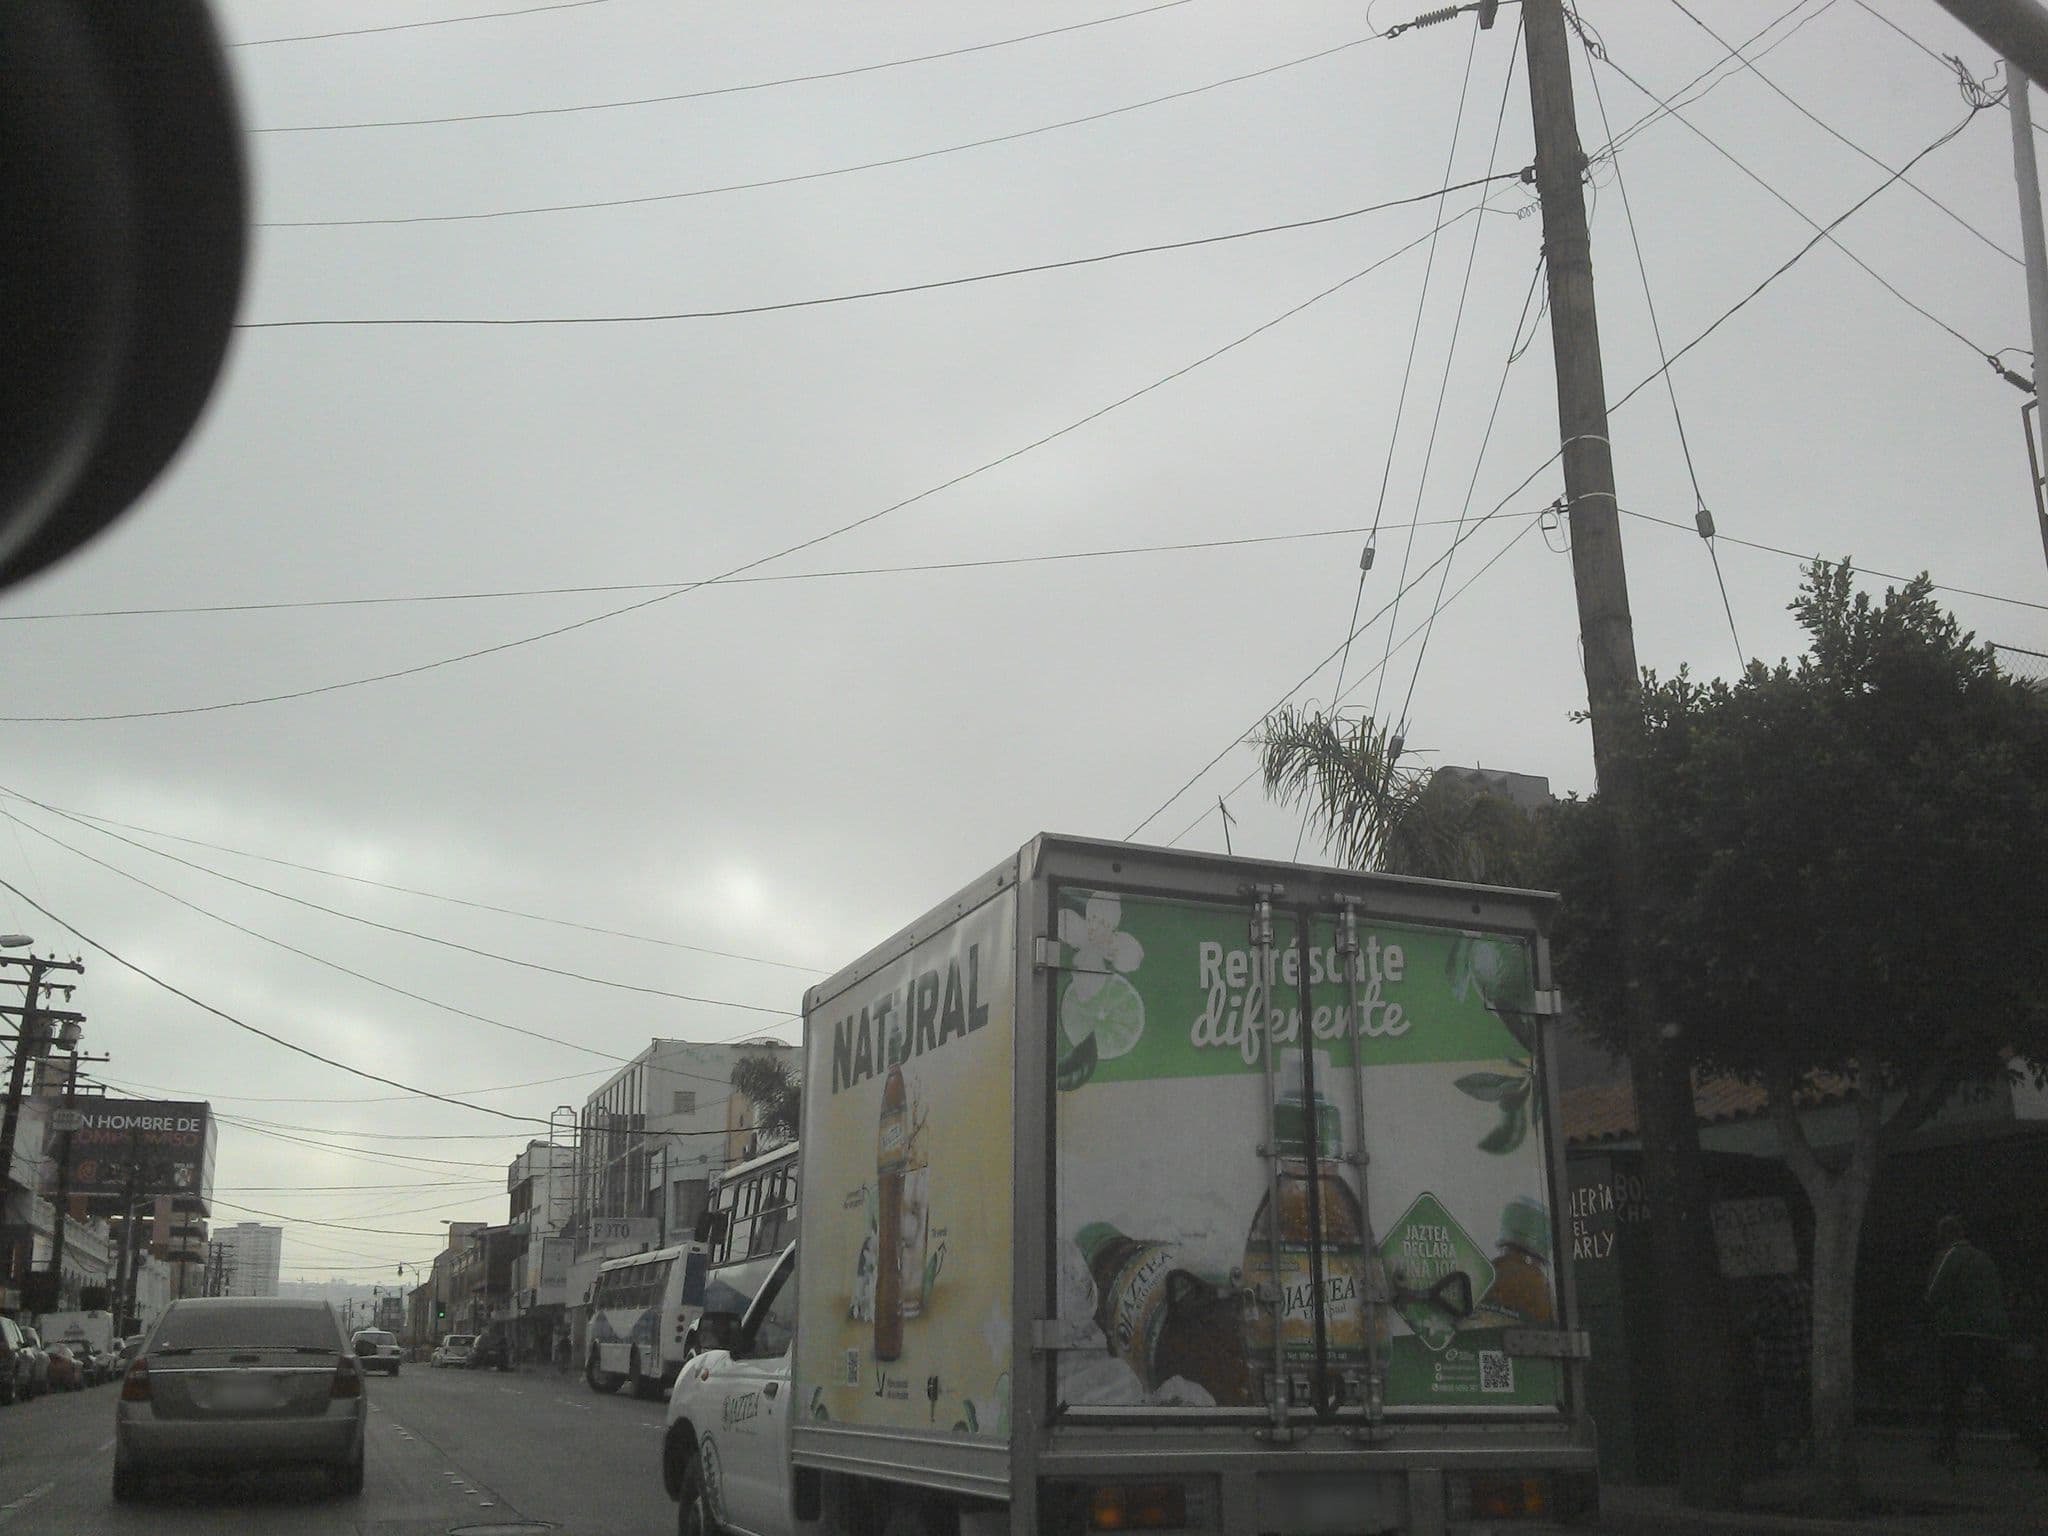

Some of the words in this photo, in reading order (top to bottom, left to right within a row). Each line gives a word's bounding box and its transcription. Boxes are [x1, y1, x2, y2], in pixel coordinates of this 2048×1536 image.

[831, 943, 989, 1096] NATURAL
[1190, 977, 1411, 1065] diferente
[98, 1114, 173, 1131] HOMBRE
[177, 1117, 201, 1132] DE
[1405, 1224, 1449, 1242] JAZTEA
[1402, 1241, 1457, 1260] DECLARA
[1284, 1276, 1356, 1317] JAZEA
